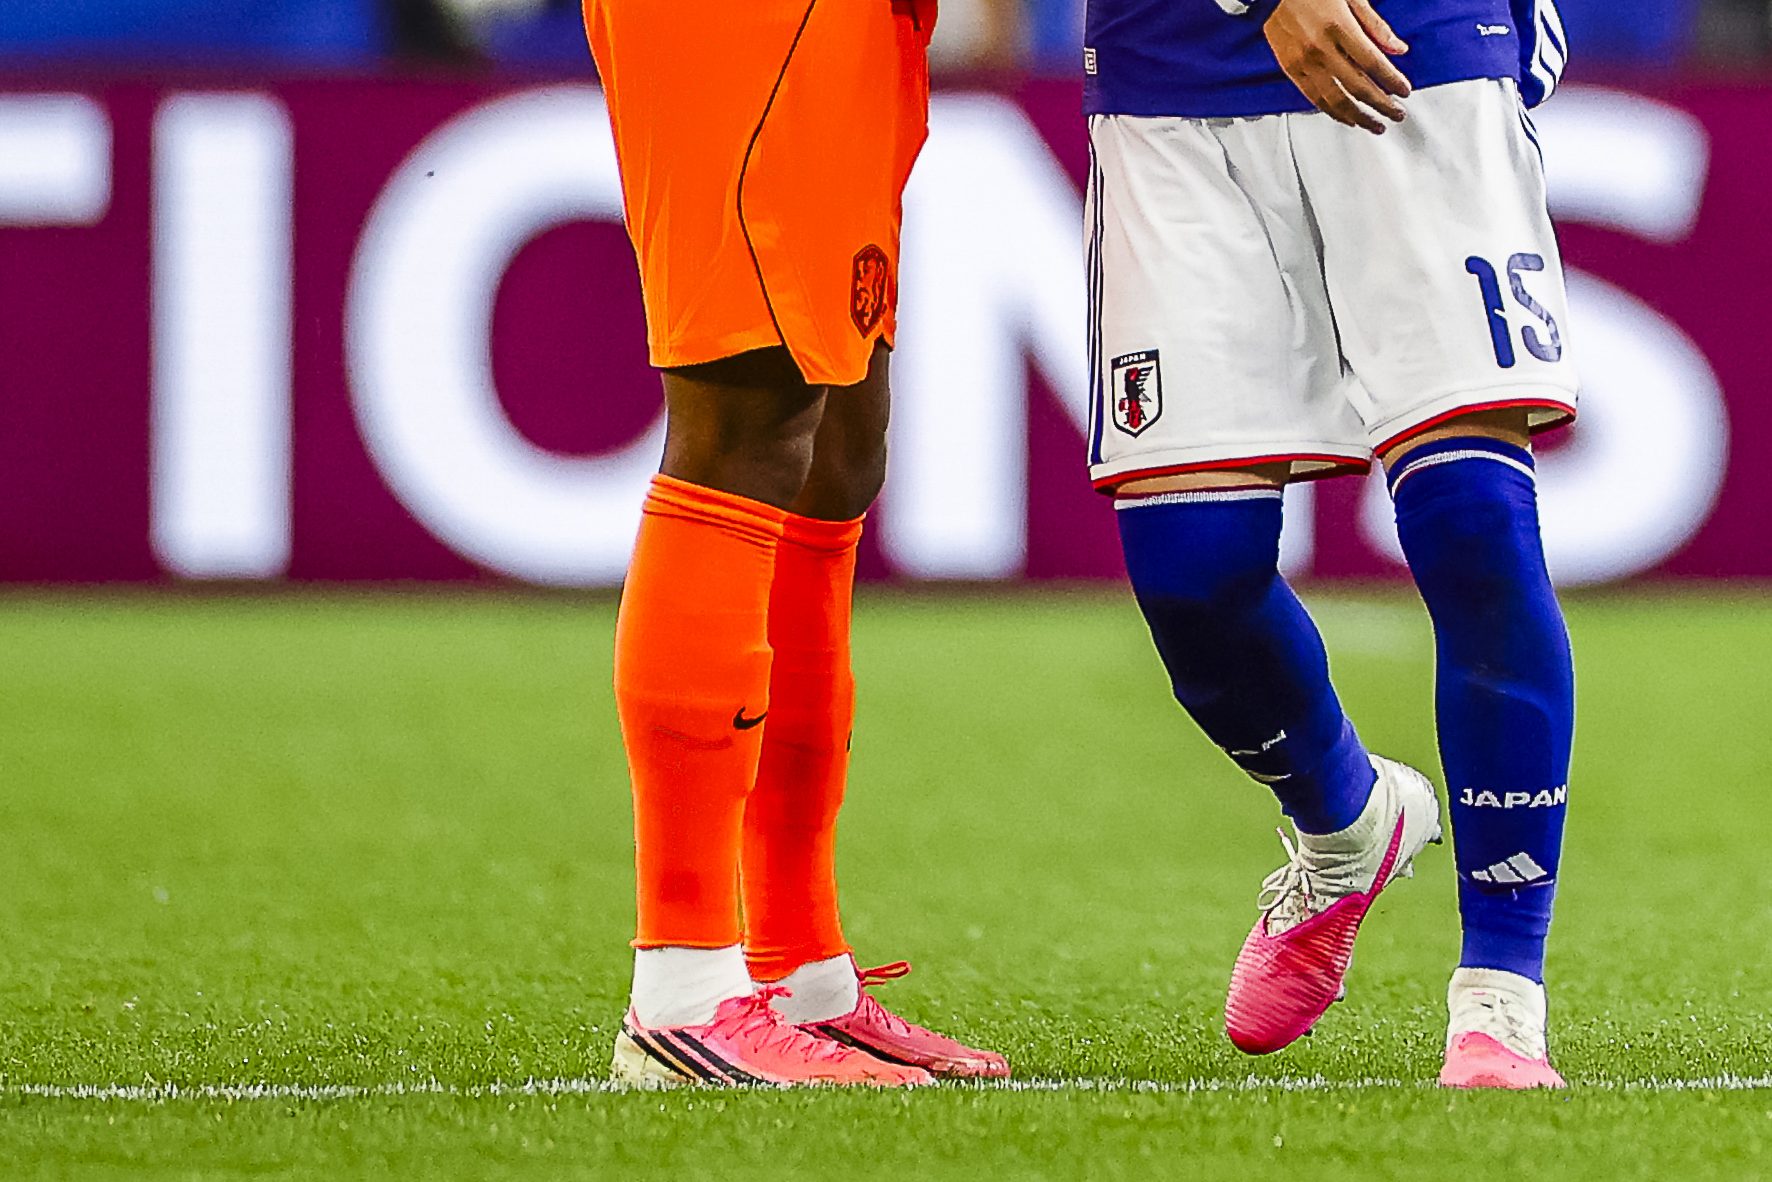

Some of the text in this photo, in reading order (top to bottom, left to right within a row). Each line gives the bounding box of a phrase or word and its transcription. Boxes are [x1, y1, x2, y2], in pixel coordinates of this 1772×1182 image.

[1465, 253, 1562, 368] 15
[1119, 353, 1146, 366] JAPAN
[1460, 784, 1567, 809] JAPAN
